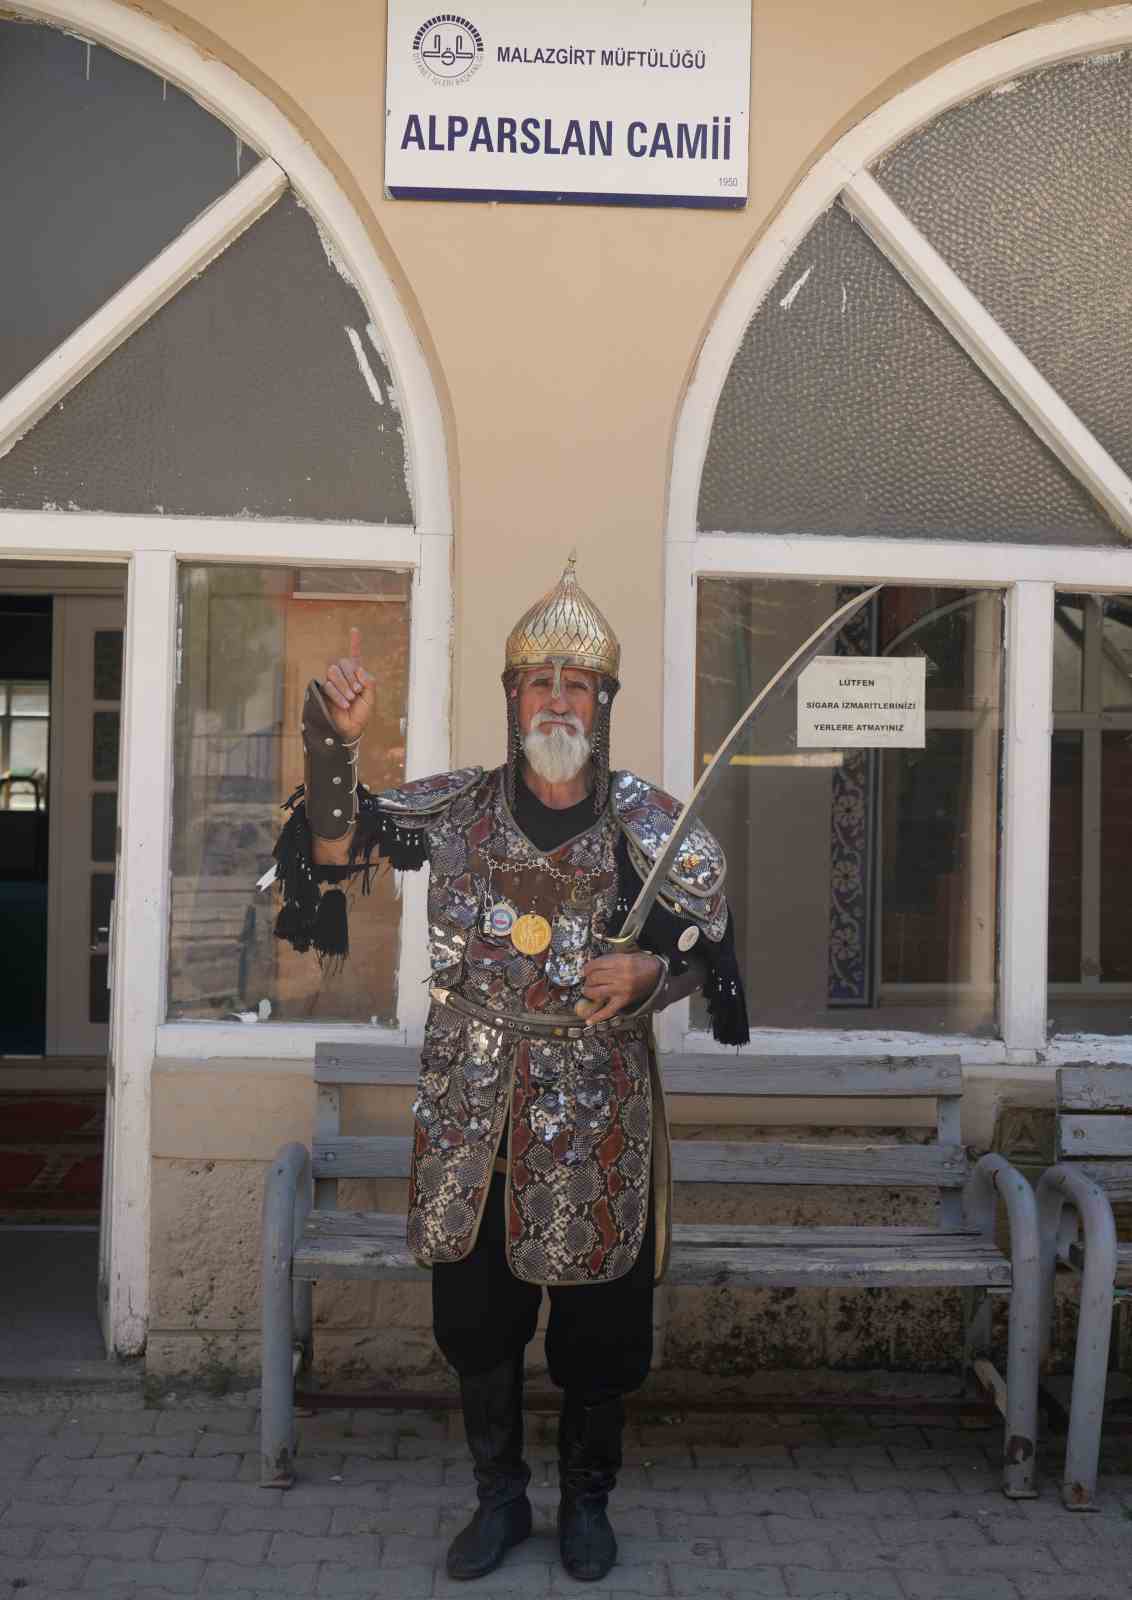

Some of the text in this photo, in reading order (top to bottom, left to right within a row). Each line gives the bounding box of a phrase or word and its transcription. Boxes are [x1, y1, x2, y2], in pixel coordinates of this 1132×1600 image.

[496, 46, 706, 70] MALAZGİRT MÜFTÜLÜĞÜ
[400, 114, 732, 161] ALPARSLAN CAMİİ
[813, 723, 905, 732] YERLERE ATMAYINIZ
